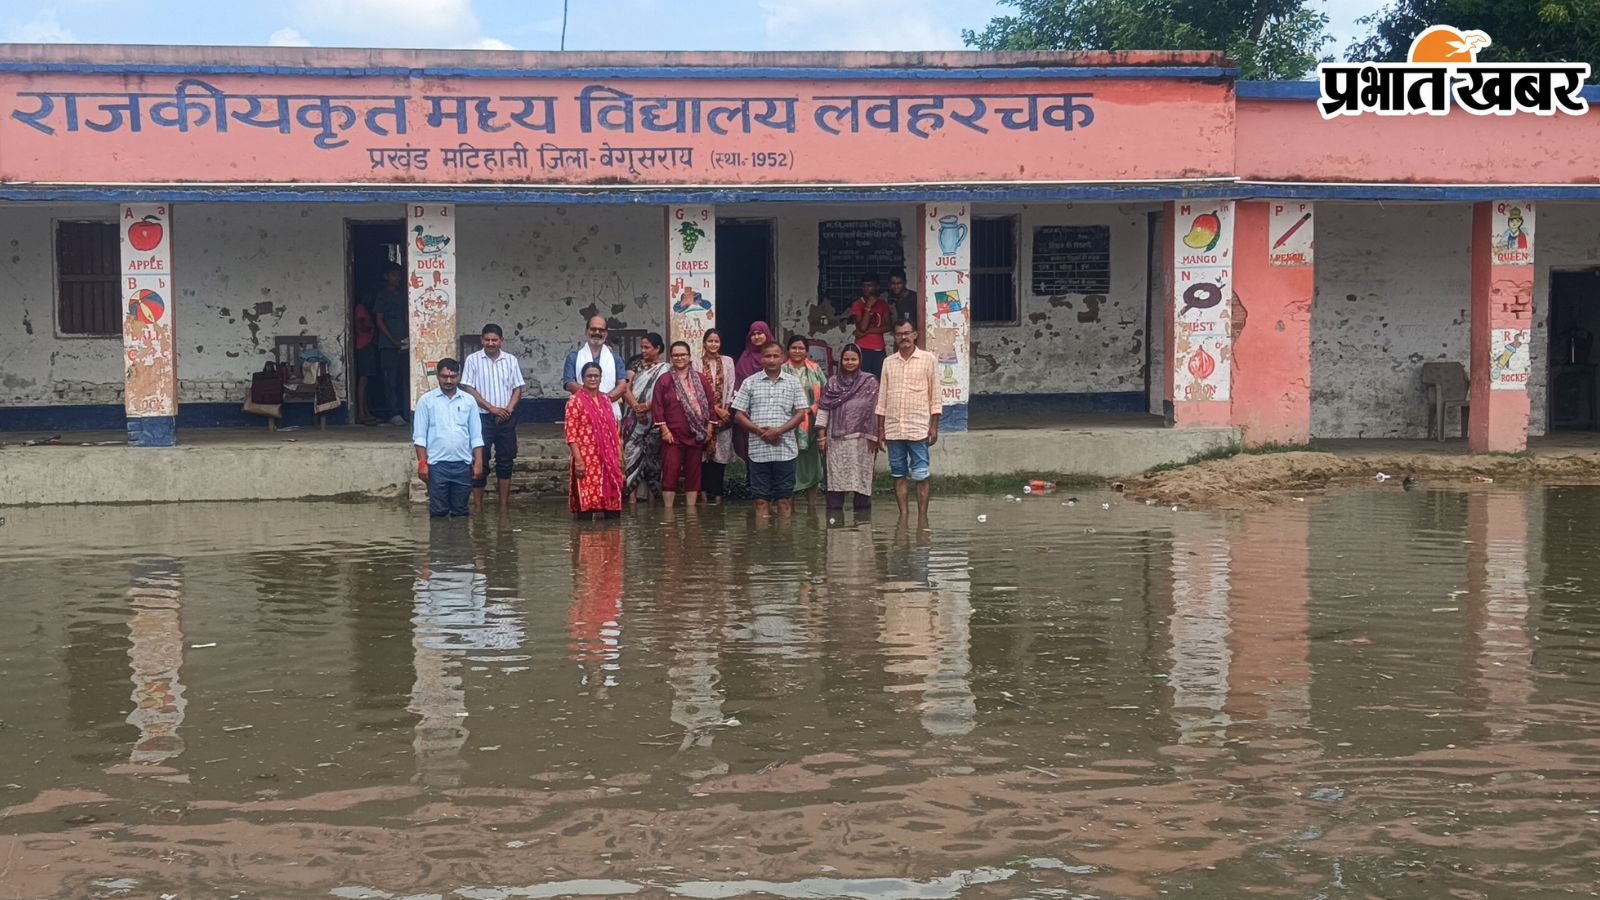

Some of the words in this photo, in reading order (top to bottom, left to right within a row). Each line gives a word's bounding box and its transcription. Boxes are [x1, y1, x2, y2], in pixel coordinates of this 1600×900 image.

[11, 78, 412, 149] राजकीयकृत
[574, 84, 799, 135] विद्यालय
[811, 92, 1095, 139] लवहरचक
[365, 143, 430, 171] प्रखंड
[124, 207, 134, 219] A
[157, 206, 166, 216] a
[414, 206, 424, 217] D
[440, 206, 447, 217] d
[929, 207, 938, 218] J
[1180, 205, 1190, 216] M
[1275, 205, 1284, 216] P
[1497, 202, 1506, 214] Q
[675, 208, 684, 220] G
[701, 208, 709, 221] g
[935, 256, 957, 267] JUG
[1182, 255, 1217, 265] MANGO
[1497, 252, 1529, 262] QUEEN
[128, 260, 164, 271] APPLE
[417, 259, 446, 270] DUCK
[675, 260, 709, 271] GRAPES
[931, 274, 940, 285] K
[1181, 271, 1190, 281] N
[1221, 269, 1228, 277] n
[127, 277, 136, 289] B
[158, 278, 165, 288] b
[442, 277, 449, 286] e
[703, 277, 710, 288] h
[1503, 330, 1511, 341] R
